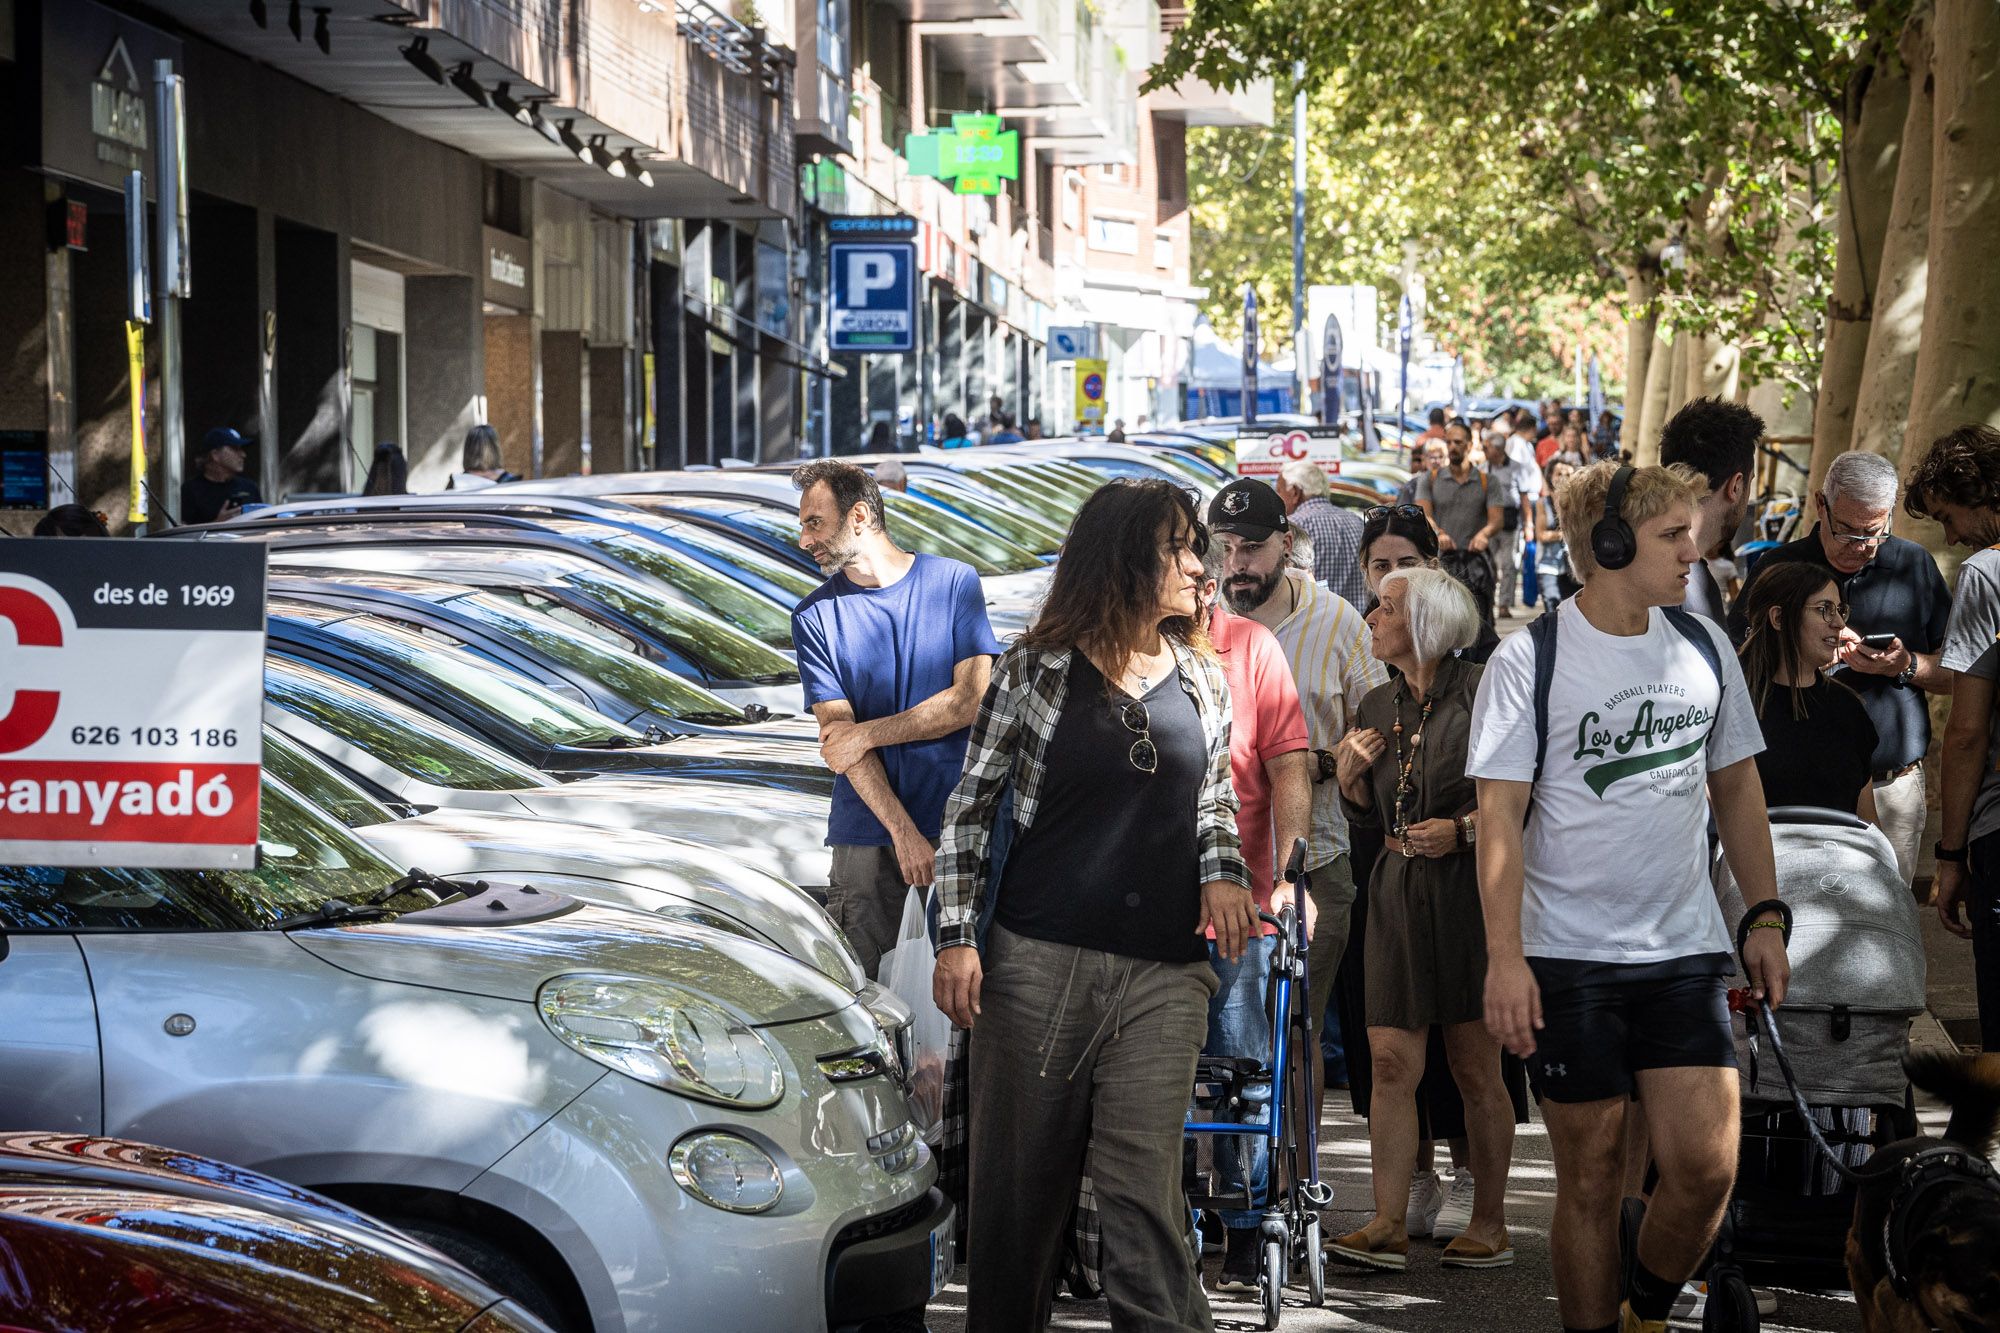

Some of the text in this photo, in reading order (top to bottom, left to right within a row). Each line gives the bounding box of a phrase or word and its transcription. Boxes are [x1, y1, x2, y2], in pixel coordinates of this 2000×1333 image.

[847, 252, 897, 308] P
[94, 582, 235, 607] des de 1969
[1604, 683, 1686, 711] BASEBALL PLAYERS
[71, 726, 238, 748] 626 103 186
[1573, 699, 1714, 760] Los Angeles
[0, 768, 235, 826] anyadó
